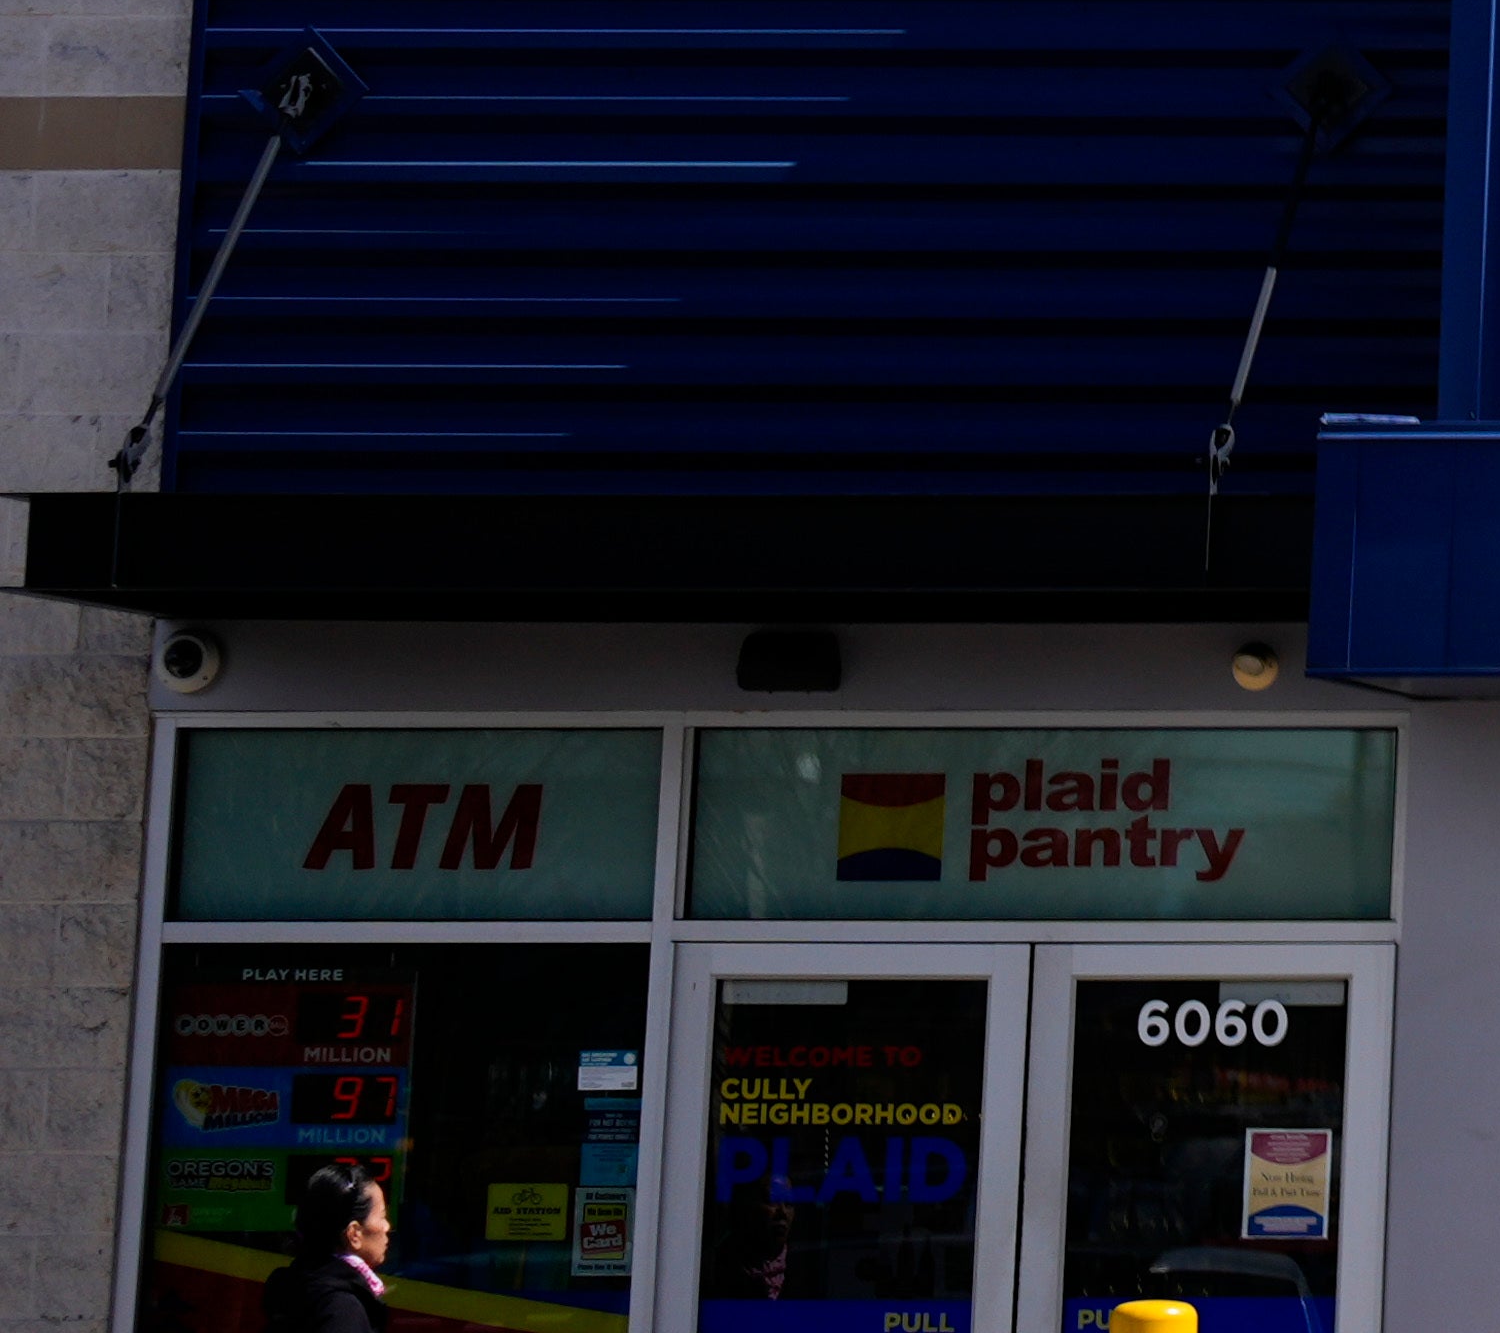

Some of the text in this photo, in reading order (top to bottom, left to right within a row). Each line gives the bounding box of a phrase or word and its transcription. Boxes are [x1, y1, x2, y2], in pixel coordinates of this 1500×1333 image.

[972, 759, 1170, 825] plaid
[302, 783, 543, 870] ATM
[969, 815, 1245, 881] pantry
[241, 968, 343, 981] PLAY HERE
[336, 995, 404, 1039] 31
[1136, 998, 1289, 1047] 6060
[303, 1047, 391, 1063] MILLION
[724, 1045, 924, 1067] WELCOME TO
[331, 1076, 398, 1120] 97
[719, 1078, 814, 1100] CULLY
[719, 1102, 963, 1125] NEIGHBORHOOD
[297, 1128, 385, 1143] MILLION
[168, 1161, 275, 1176] OREGON'S
[714, 1135, 967, 1205] PLAID
[589, 1222, 617, 1237] We
[582, 1234, 624, 1250] Card
[884, 1312, 955, 1333] PULL
[1077, 1309, 1113, 1331] PU
